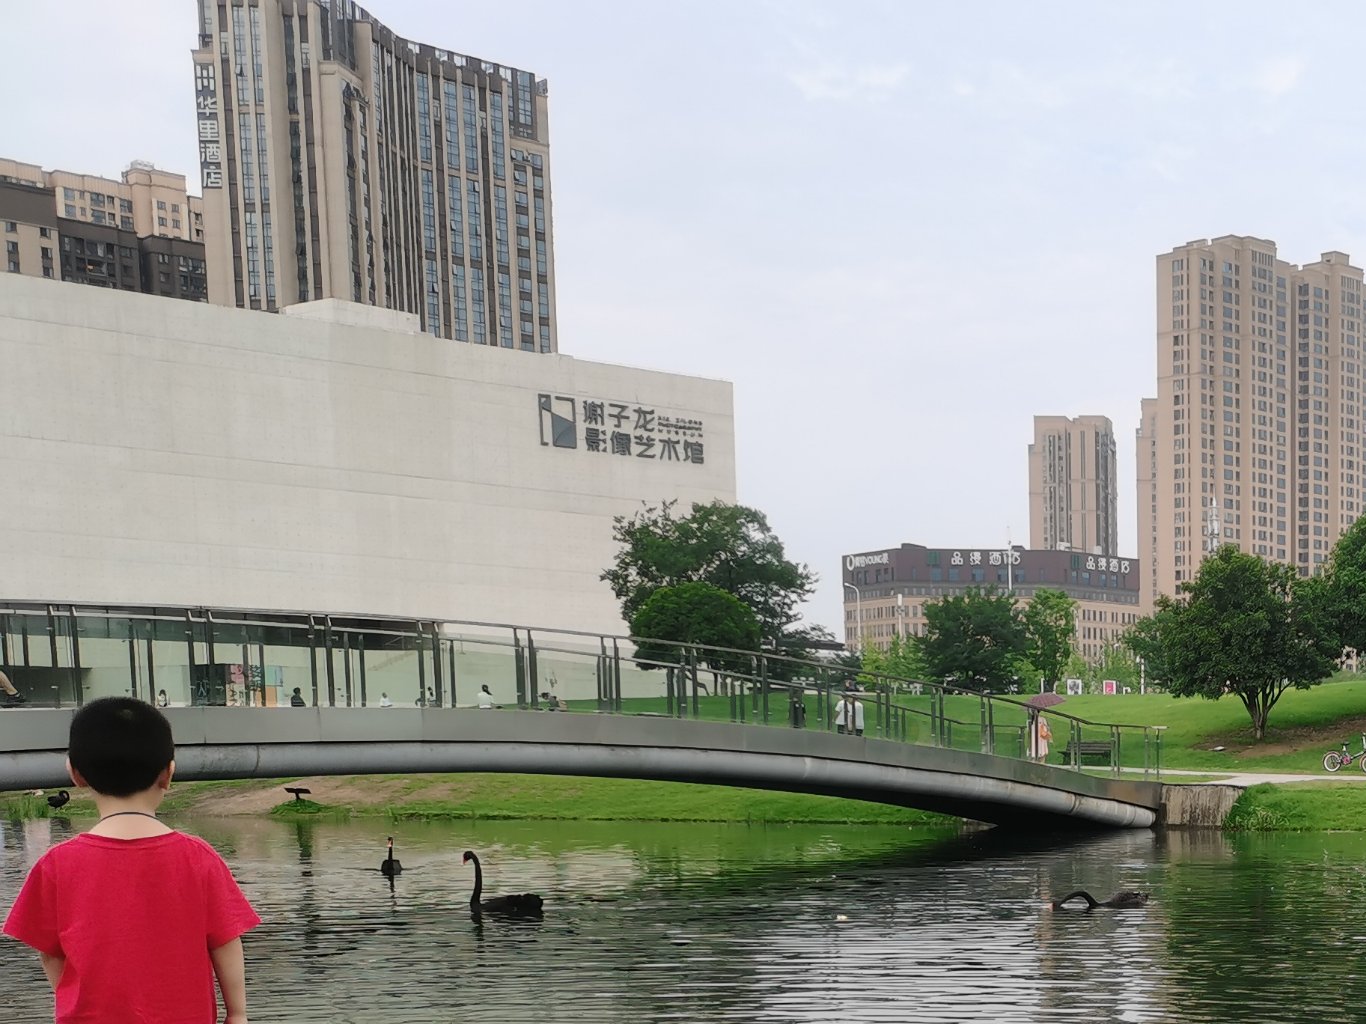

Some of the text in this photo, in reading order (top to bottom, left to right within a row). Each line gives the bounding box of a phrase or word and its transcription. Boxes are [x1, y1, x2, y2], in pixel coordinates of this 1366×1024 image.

[583, 400, 655, 432] 谢子龙
[585, 427, 704, 464] 影像艺术馆
